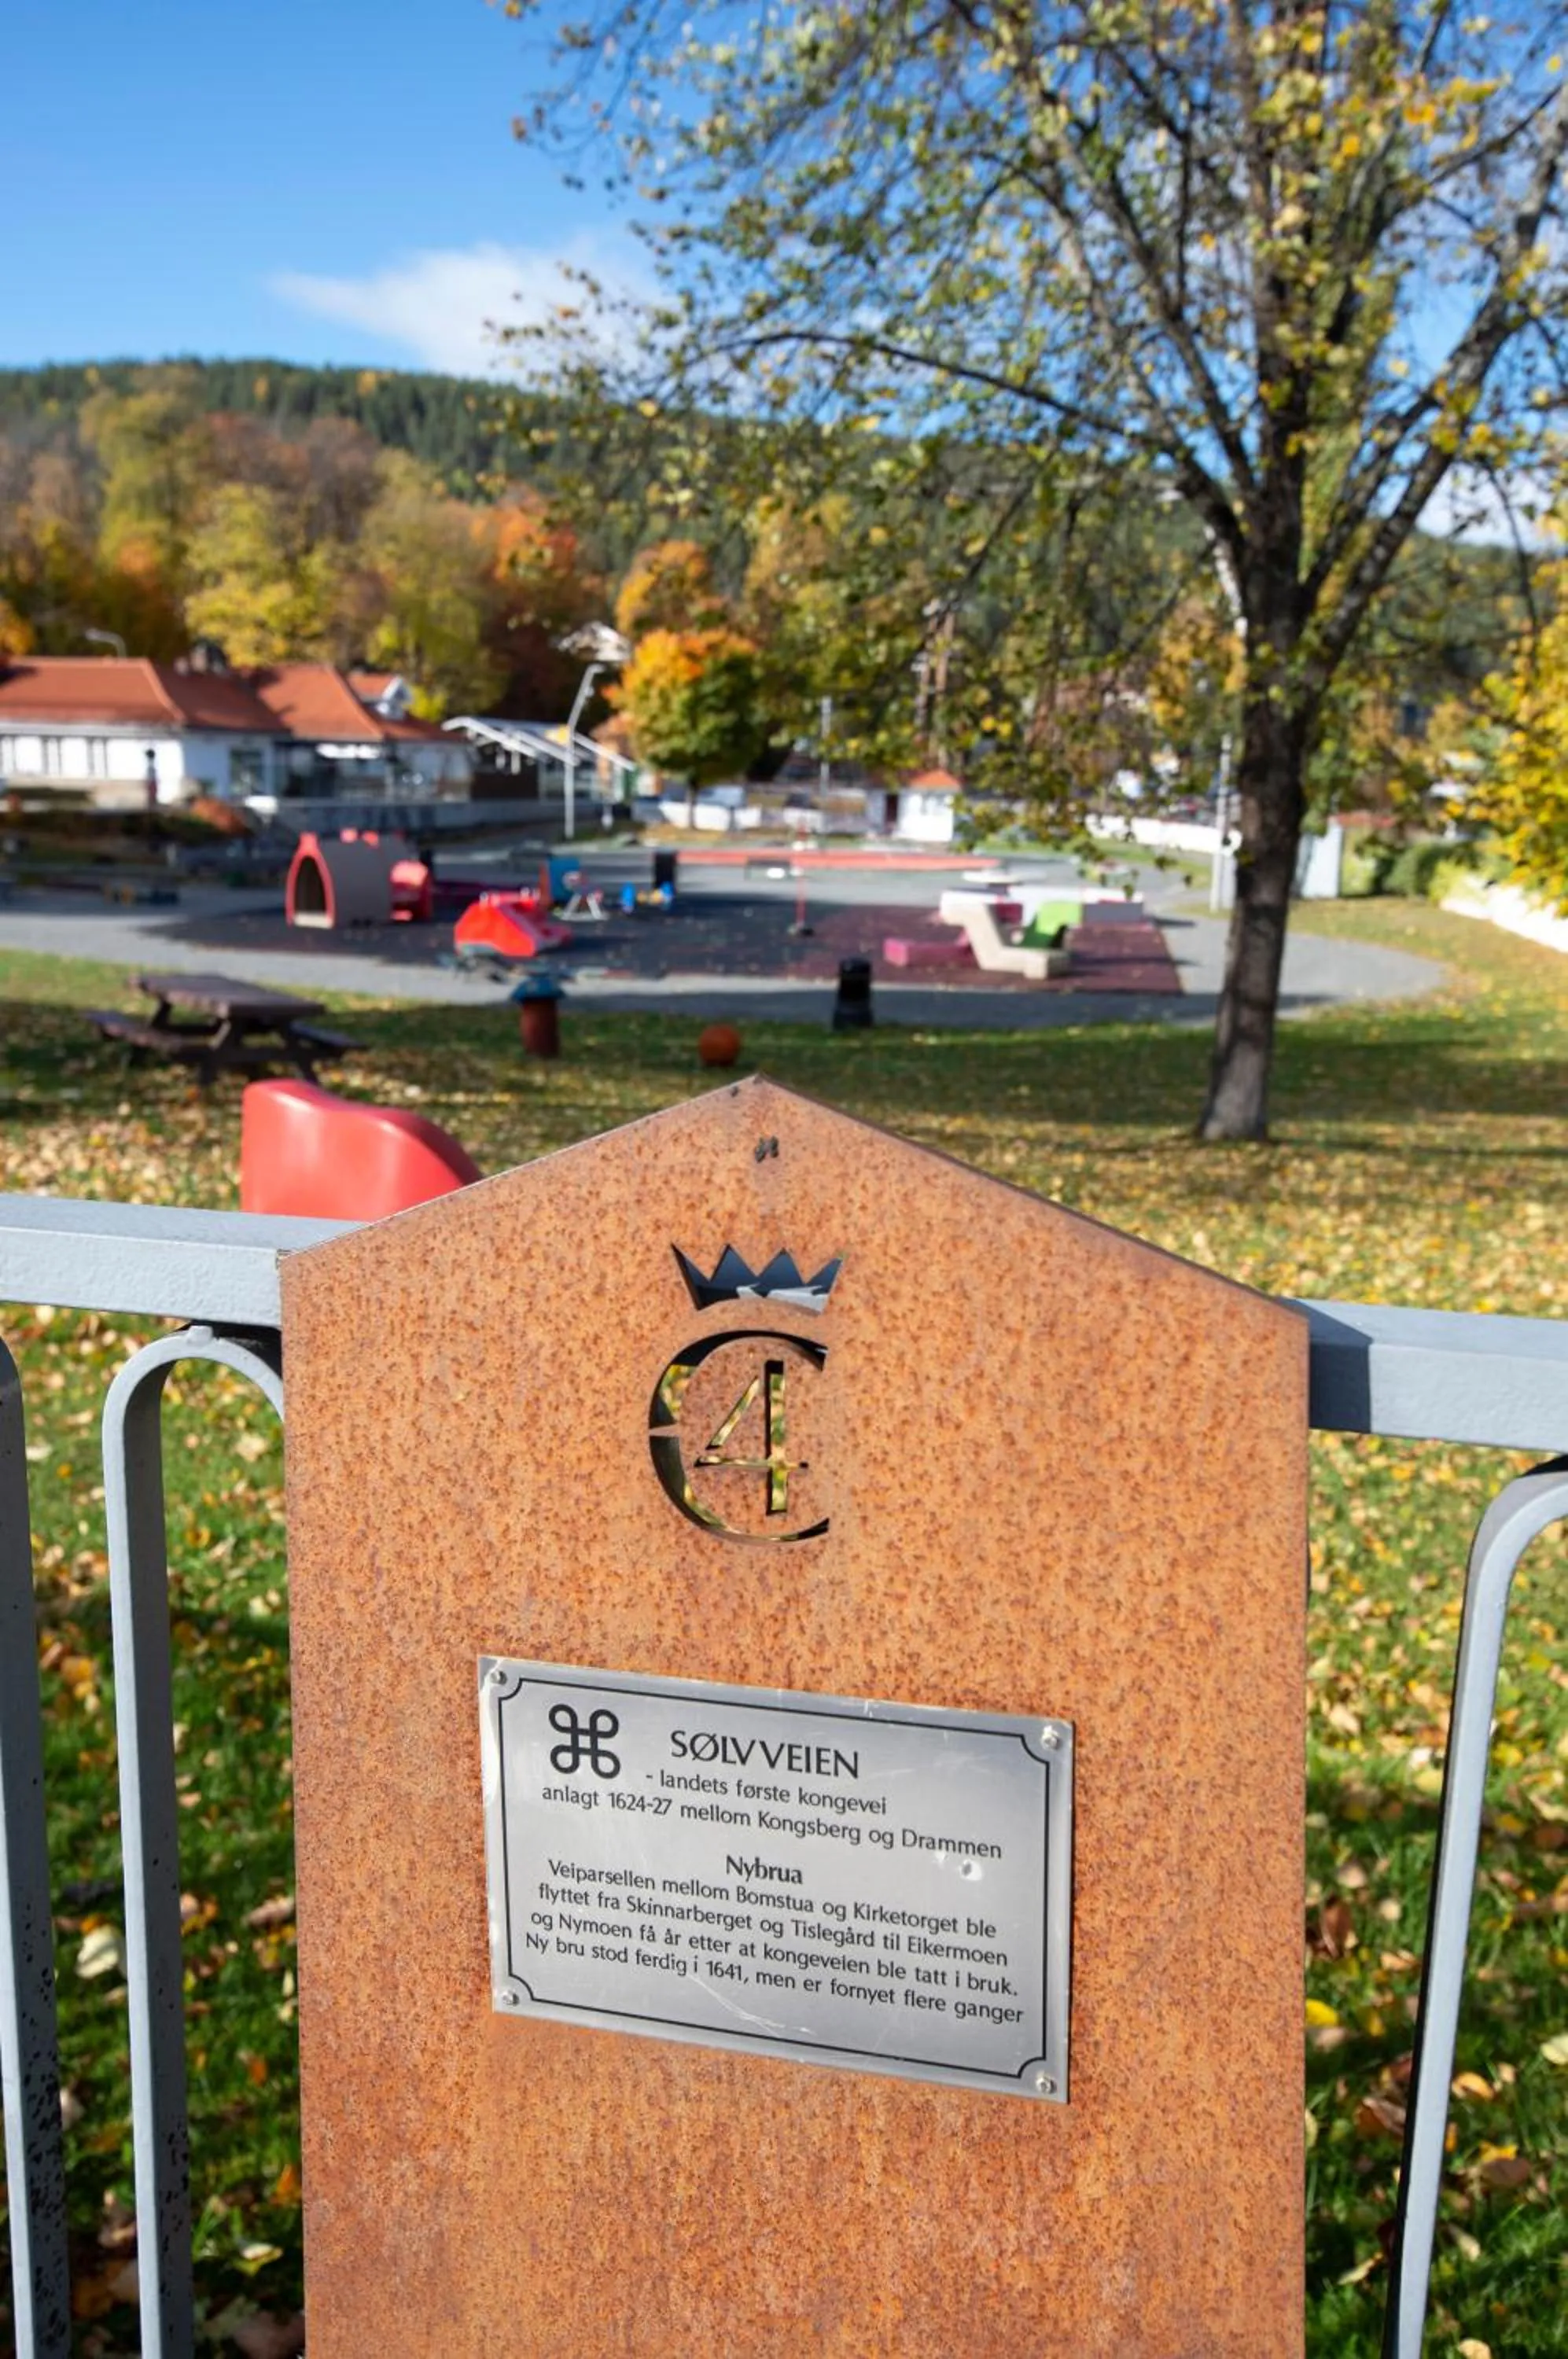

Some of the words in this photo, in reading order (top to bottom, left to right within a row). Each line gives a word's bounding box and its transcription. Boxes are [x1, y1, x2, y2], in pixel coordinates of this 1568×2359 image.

[660, 1768, 728, 1795] landets
[736, 1779, 790, 1803] første
[798, 1786, 886, 1815] kongevei
[670, 1729, 859, 1779] SØLVVEIEN
[542, 1784, 599, 1811] anlagt
[607, 1792, 673, 1816] 1624-27
[680, 1804, 751, 1827] mellom
[757, 1810, 861, 1846] Kongsberg
[868, 1829, 894, 1850] og
[902, 1828, 1002, 1859] Drammen
[547, 1859, 656, 1890] Veiparsellen
[662, 1879, 730, 1901] mellom
[736, 1885, 814, 1913] Bomstua
[822, 1901, 847, 1923] og
[853, 1901, 959, 1935] Kirketorget
[966, 1917, 997, 1938] ble
[726, 1854, 803, 1885] Nybrua
[531, 1912, 554, 1932] og
[559, 1912, 633, 1939] Nymoen
[639, 1923, 657, 1943] få
[664, 1927, 682, 1946] år
[688, 1935, 731, 1954] etter
[738, 1942, 756, 1958] at
[764, 1941, 870, 1974] kongeveien
[877, 1959, 907, 1980] ble
[915, 1967, 947, 1986] tatt
[967, 1971, 1018, 1997] bruk.
[538, 1882, 590, 1906] flyttet
[597, 1890, 620, 1910] fra
[626, 1895, 753, 1932] Skinnarberget
[760, 1919, 784, 1939] og
[790, 1919, 875, 1948] Tislegård
[882, 1934, 900, 1951] til
[907, 1935, 1008, 1967] Eikermoen
[525, 1931, 550, 1955] Ny
[556, 1937, 585, 1956] bru
[591, 1945, 628, 1963] stod
[635, 1949, 687, 1977] ferdig
[705, 1960, 749, 1985] 1641,
[756, 1971, 796, 1989] men
[803, 1978, 822, 1993] er
[830, 1978, 896, 2005] fornyet
[904, 1989, 947, 2011] flere
[954, 2001, 1024, 2025] ganger
